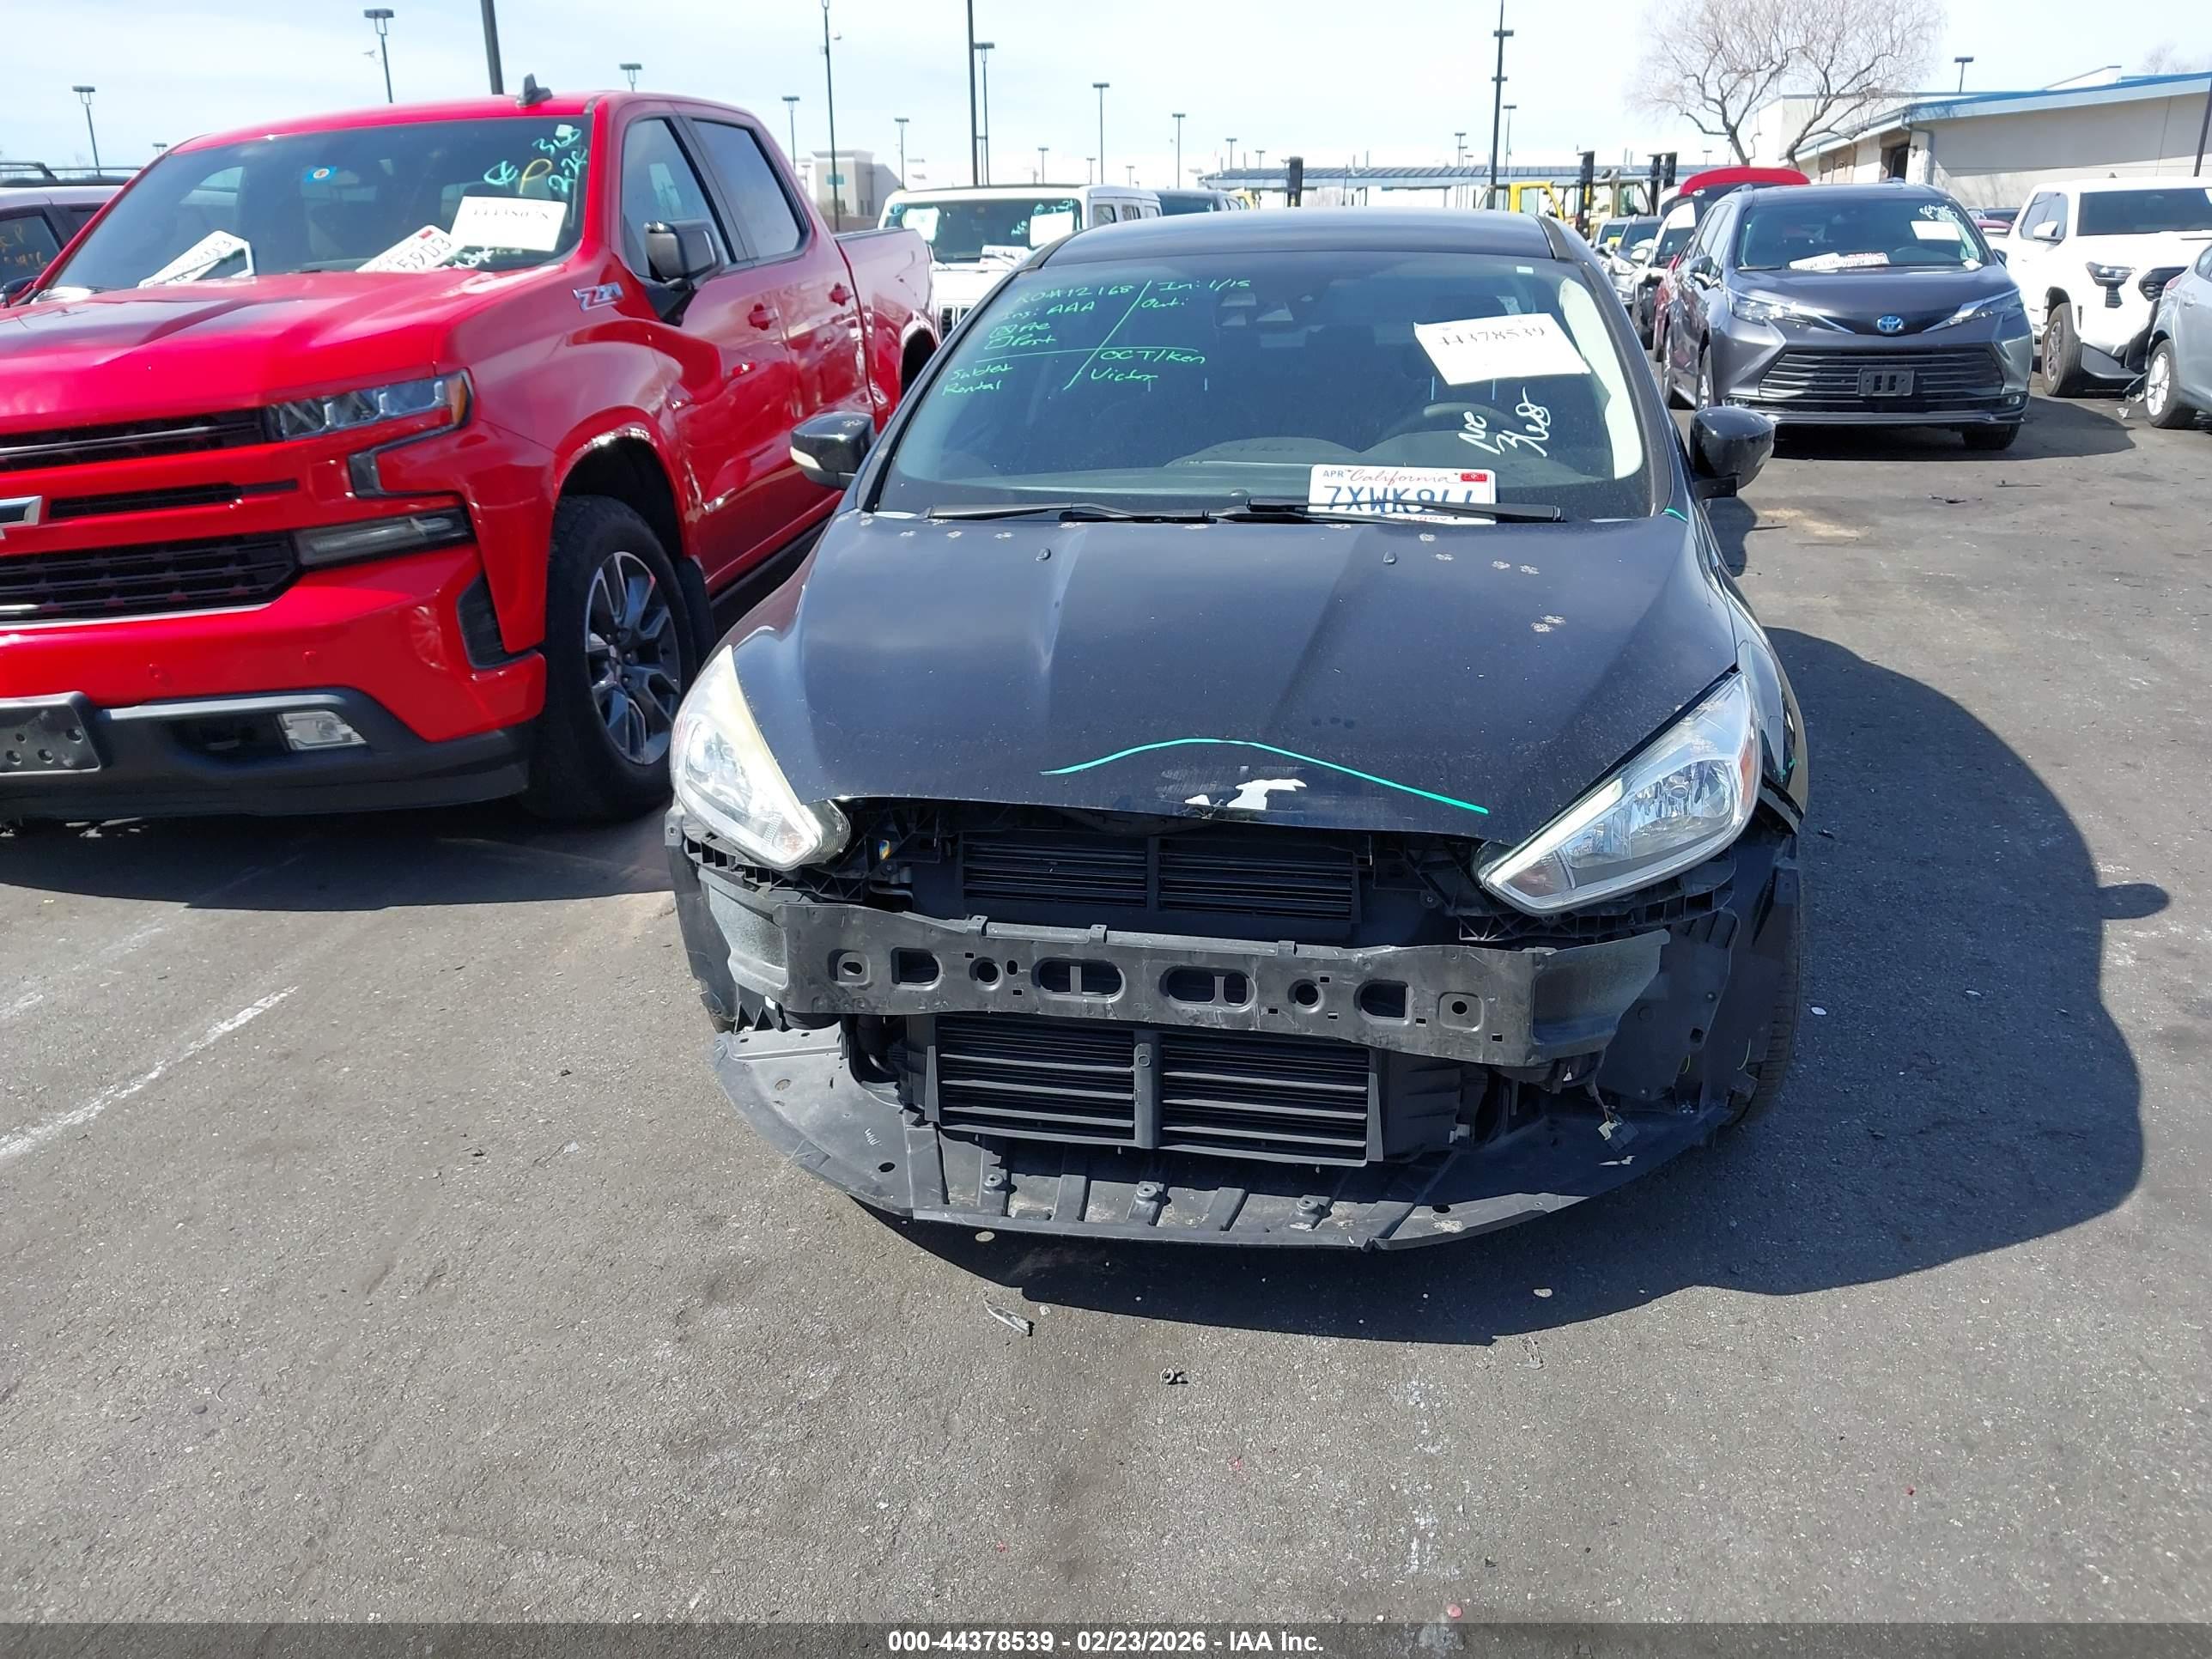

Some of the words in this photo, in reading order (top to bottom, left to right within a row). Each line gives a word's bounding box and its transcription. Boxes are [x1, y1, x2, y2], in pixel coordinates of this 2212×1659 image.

[571, 281, 624, 312] Z71
[1046, 301, 1096, 315] AAA
[1322, 470, 1345, 478] APR
[1349, 469, 1458, 486] California
